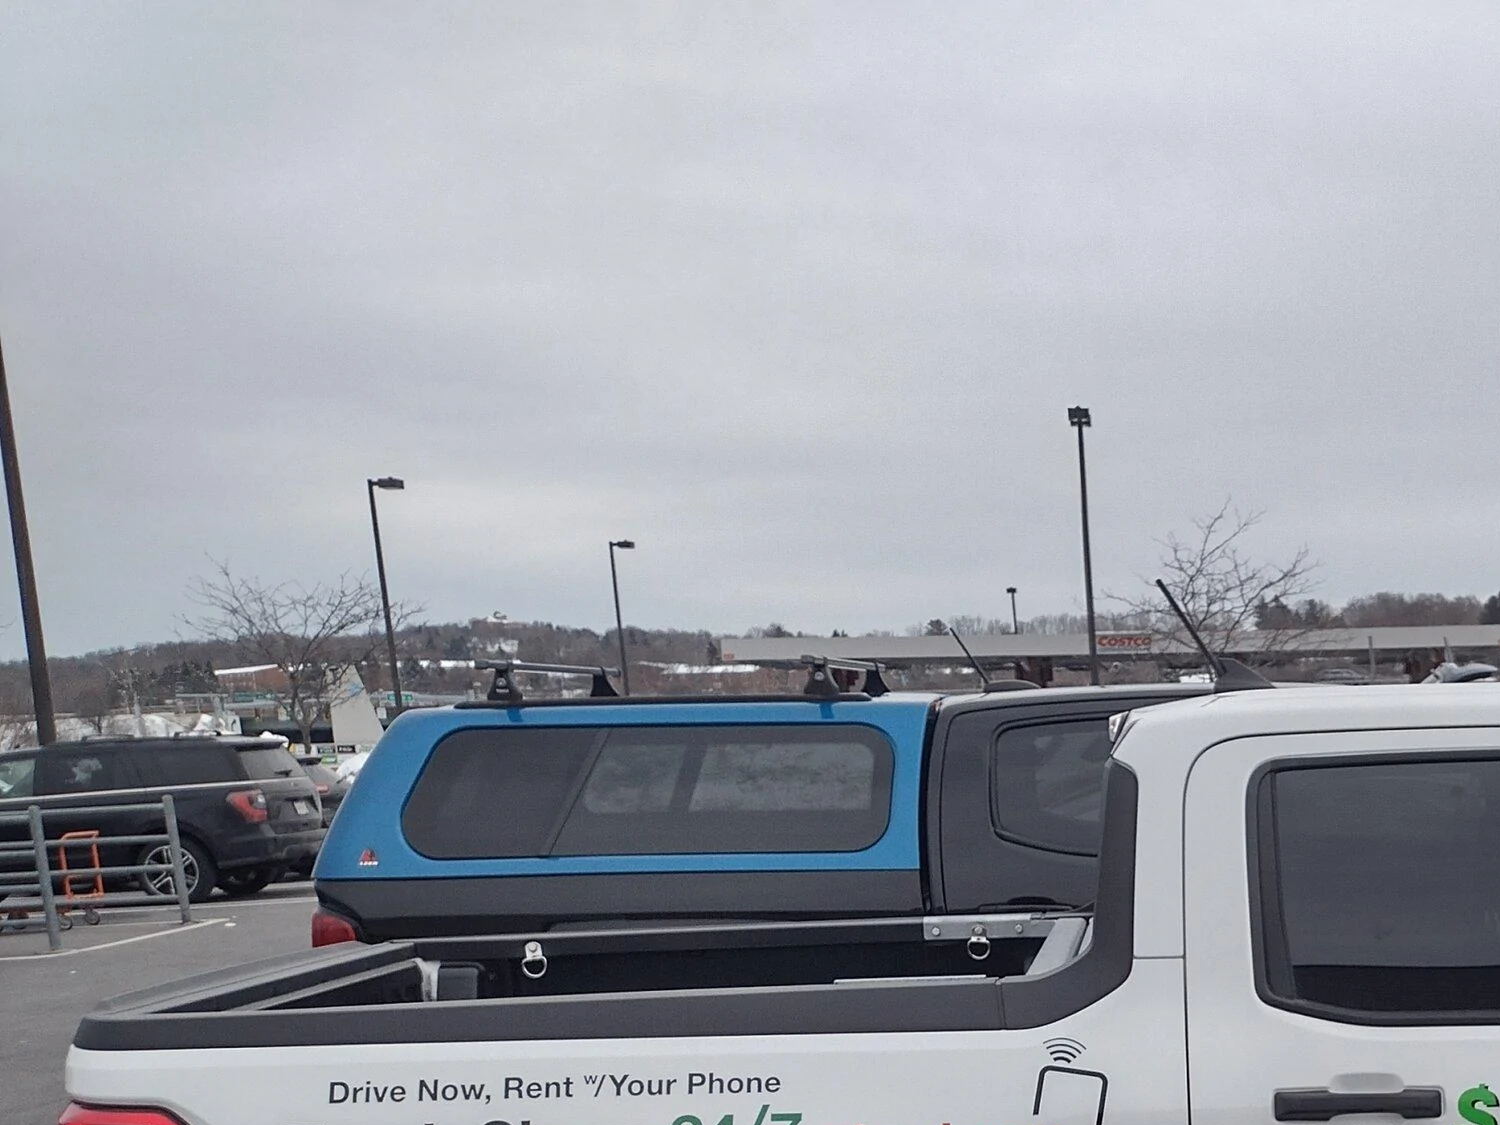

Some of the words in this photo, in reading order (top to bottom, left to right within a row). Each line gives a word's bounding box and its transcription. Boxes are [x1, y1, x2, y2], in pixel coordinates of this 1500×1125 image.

[1097, 636, 1152, 647] COSTCO
[328, 1080, 407, 1105] Drive
[418, 1078, 492, 1105] Now,
[503, 1076, 575, 1100] Rent
[687, 1072, 781, 1095] Phone
